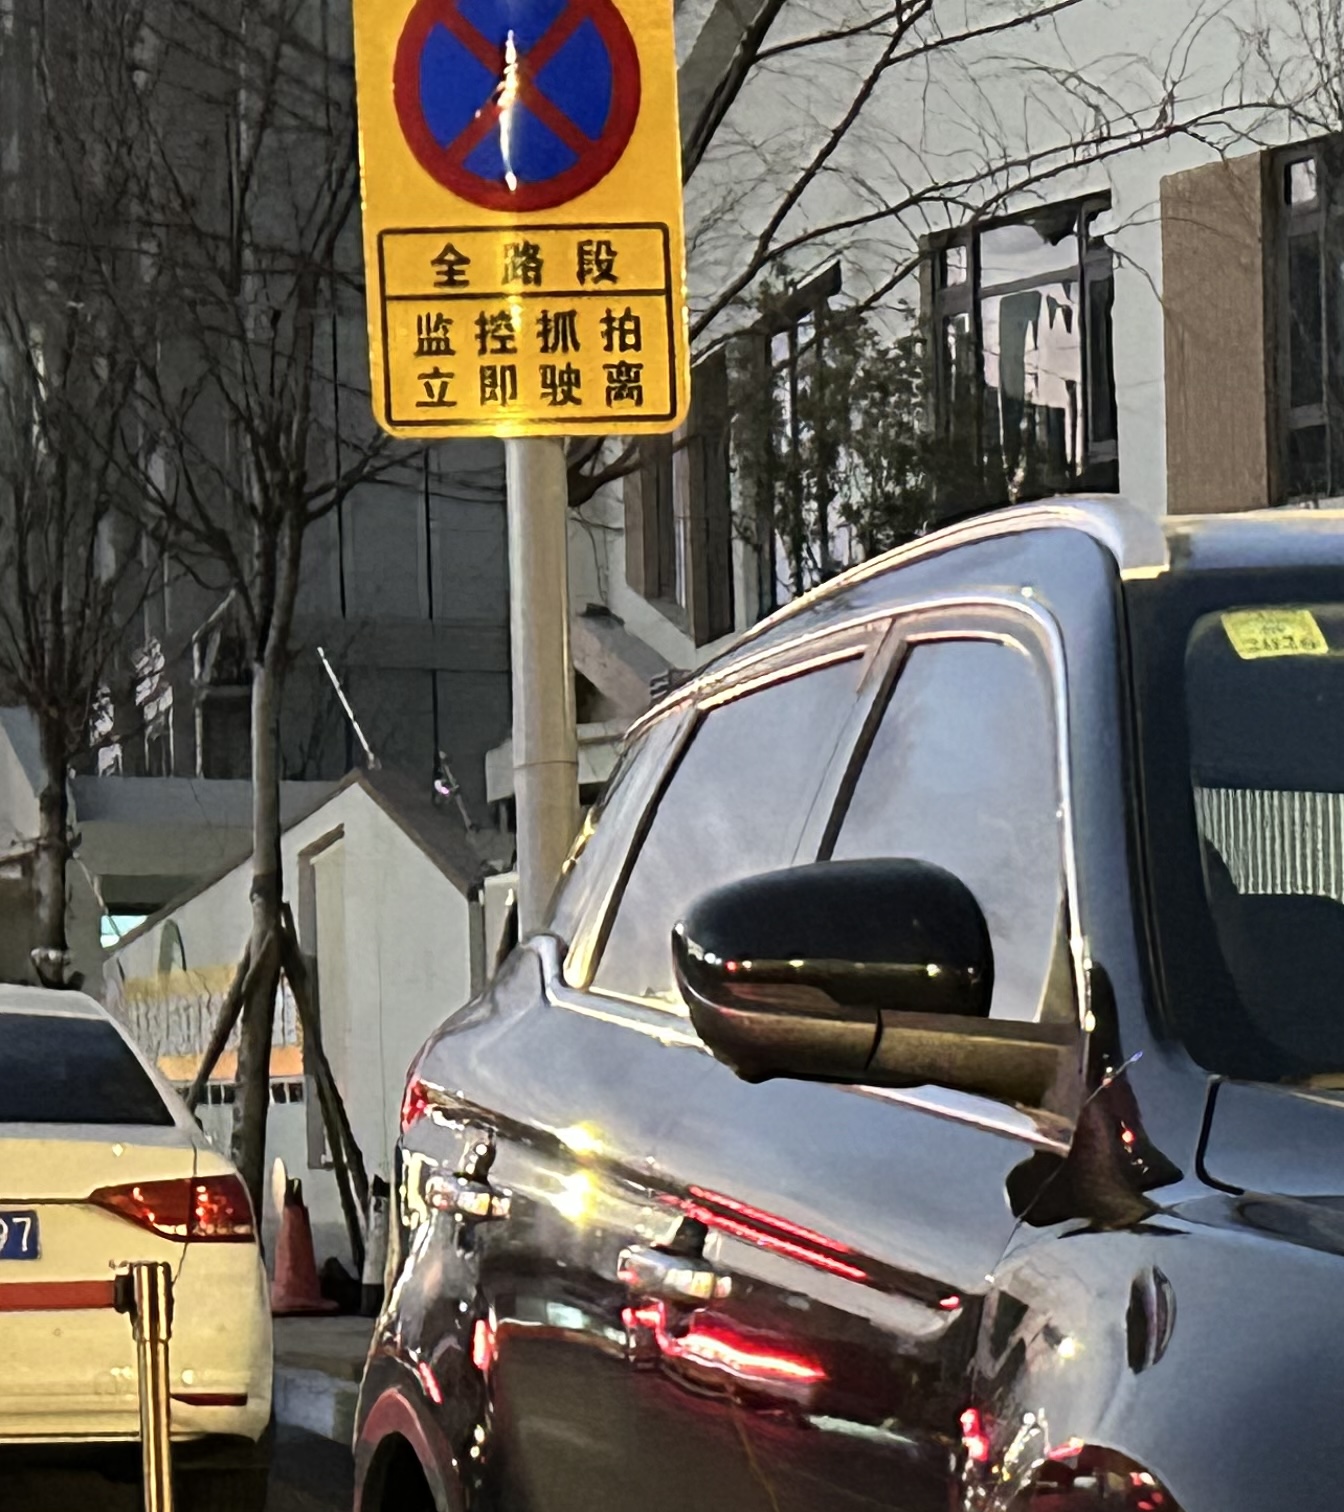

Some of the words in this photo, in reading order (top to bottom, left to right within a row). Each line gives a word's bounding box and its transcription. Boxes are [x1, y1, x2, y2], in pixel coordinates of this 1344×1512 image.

[431, 240, 617, 287] 全路段
[415, 307, 641, 356] 监控抓拍
[416, 361, 644, 408] 立即驶离
